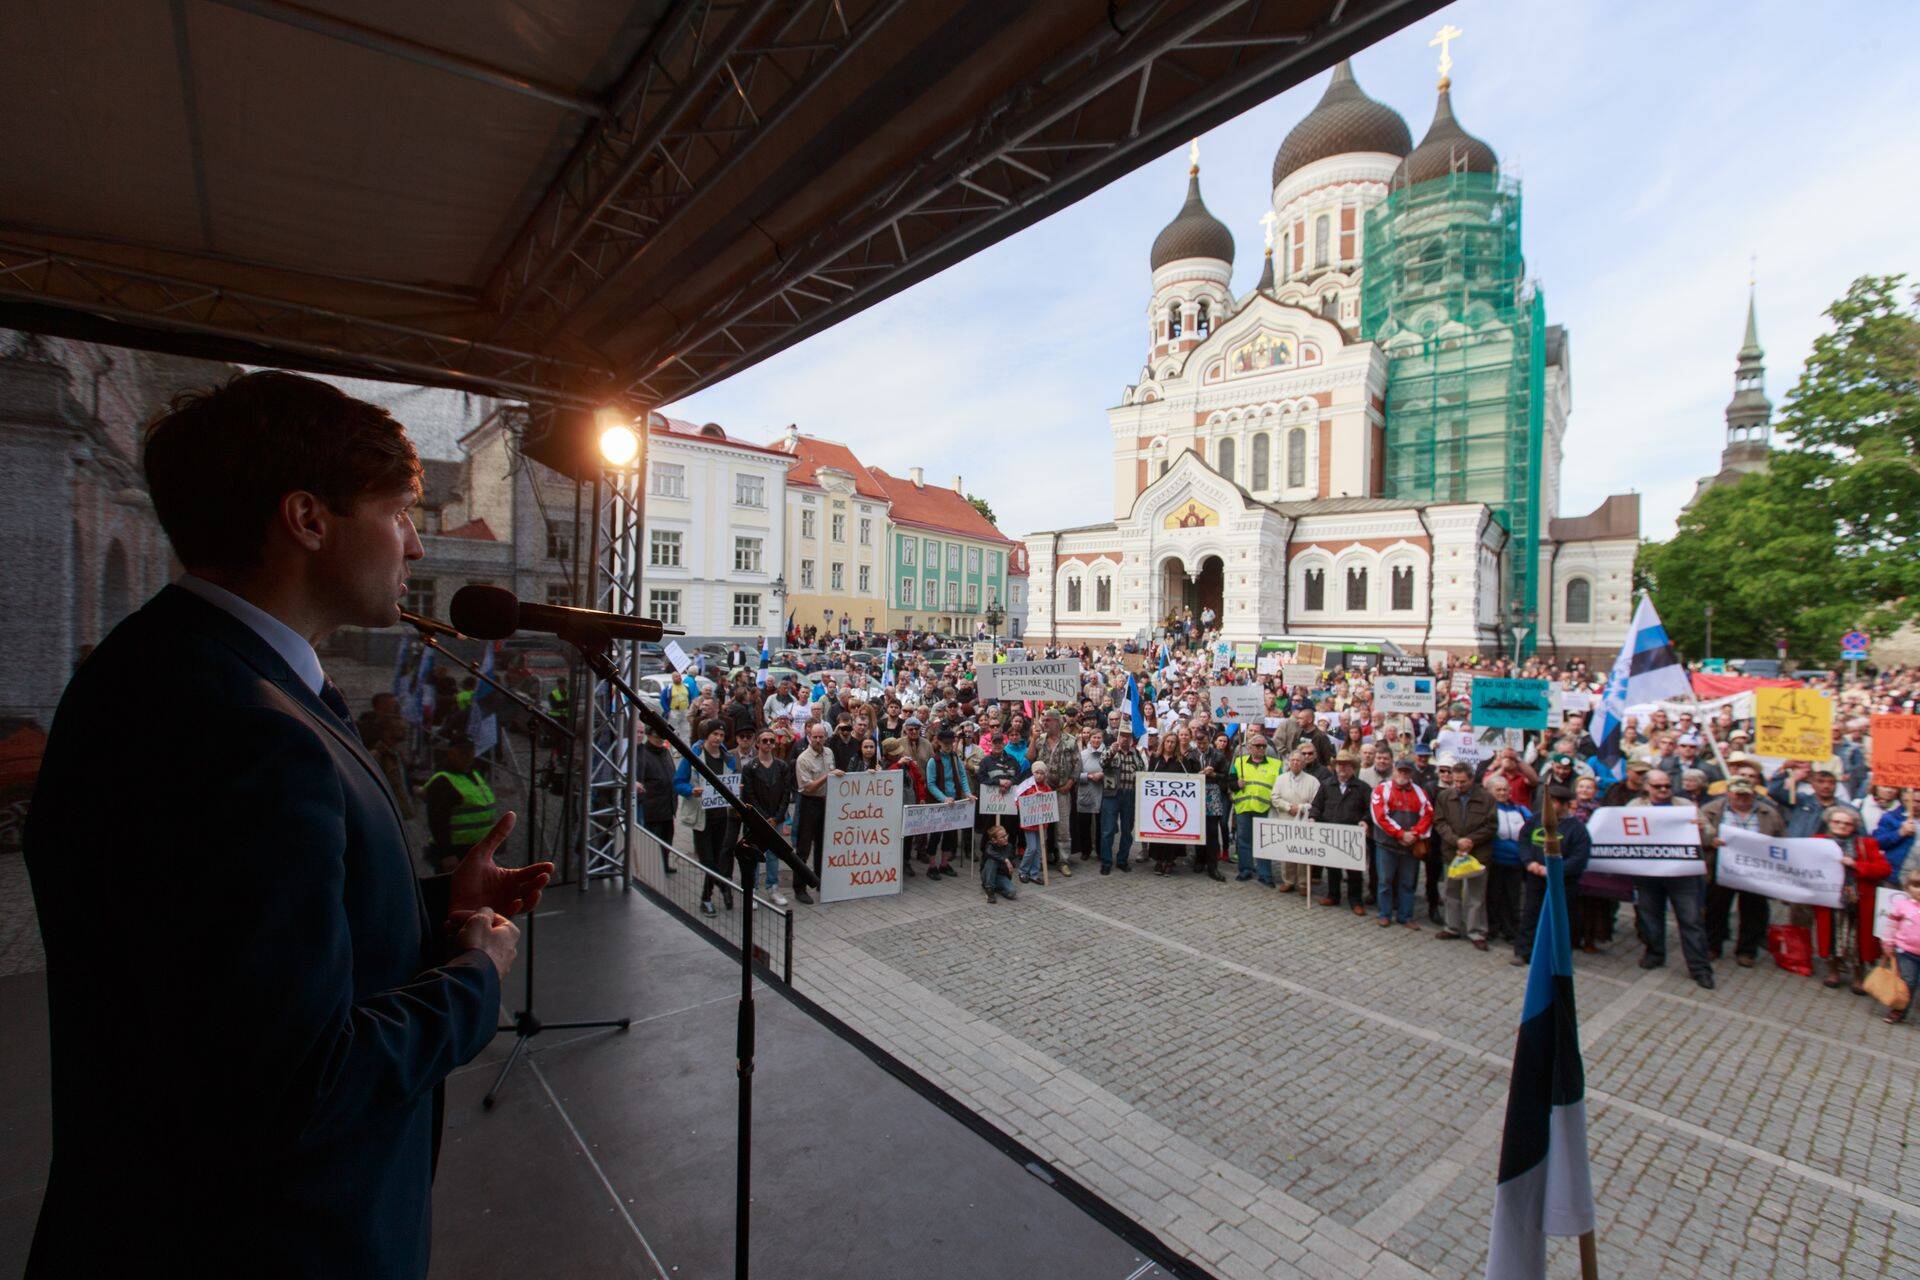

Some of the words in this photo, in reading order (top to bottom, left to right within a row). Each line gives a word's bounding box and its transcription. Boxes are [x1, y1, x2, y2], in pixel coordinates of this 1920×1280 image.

[992, 666, 1028, 678] EESTI
[1032, 663, 1067, 676] KVOOT
[1000, 680, 1026, 696] EESTI
[1042, 678, 1076, 698] SELLEKS
[839, 780, 860, 797] ON
[865, 780, 894, 796] AEG
[1145, 780, 1196, 790] STOP
[1145, 788, 1196, 798] ISLAM
[838, 802, 884, 820] Saata
[1622, 816, 1650, 836] EI
[1260, 823, 1292, 848] EESTI
[1319, 827, 1364, 862] SELLEKS
[1286, 844, 1326, 858] VALMIS
[1591, 846, 1698, 858] MMIGRATSIOONILE
[1769, 846, 1788, 861] EI
[1735, 854, 1774, 870] EESTI
